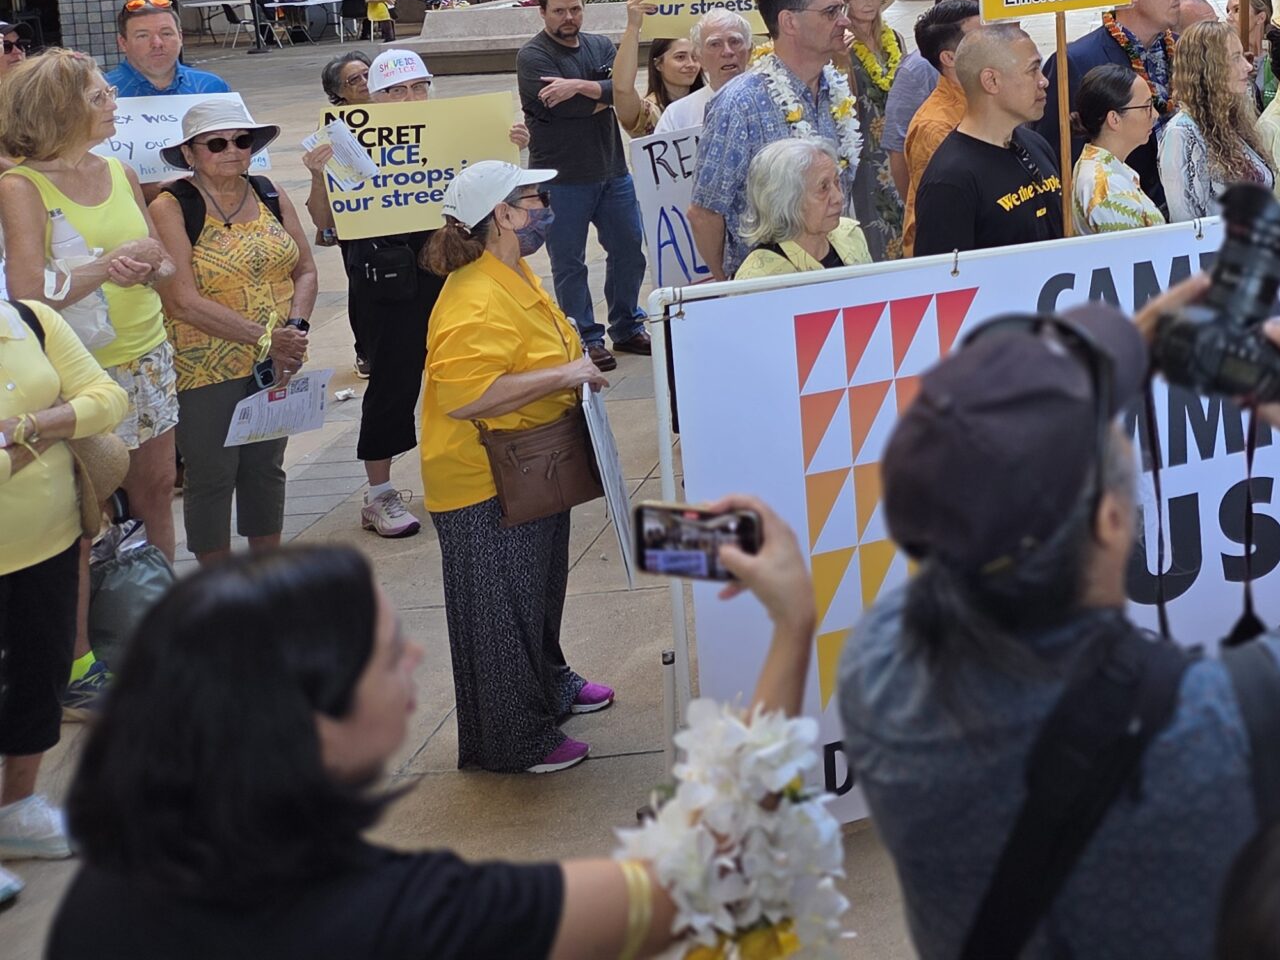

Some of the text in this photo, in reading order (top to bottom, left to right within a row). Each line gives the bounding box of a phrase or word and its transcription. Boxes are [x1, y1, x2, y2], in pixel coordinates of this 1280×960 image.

[142, 113, 178, 123] was
[324, 109, 369, 129] NO
[350, 124, 426, 148] CRET
[108, 138, 171, 160] by our
[139, 164, 156, 176] his
[642, 136, 700, 185] RE
[371, 167, 455, 190] troops
[332, 195, 374, 213] our
[996, 193, 1020, 211] We
[1018, 185, 1035, 202] the
